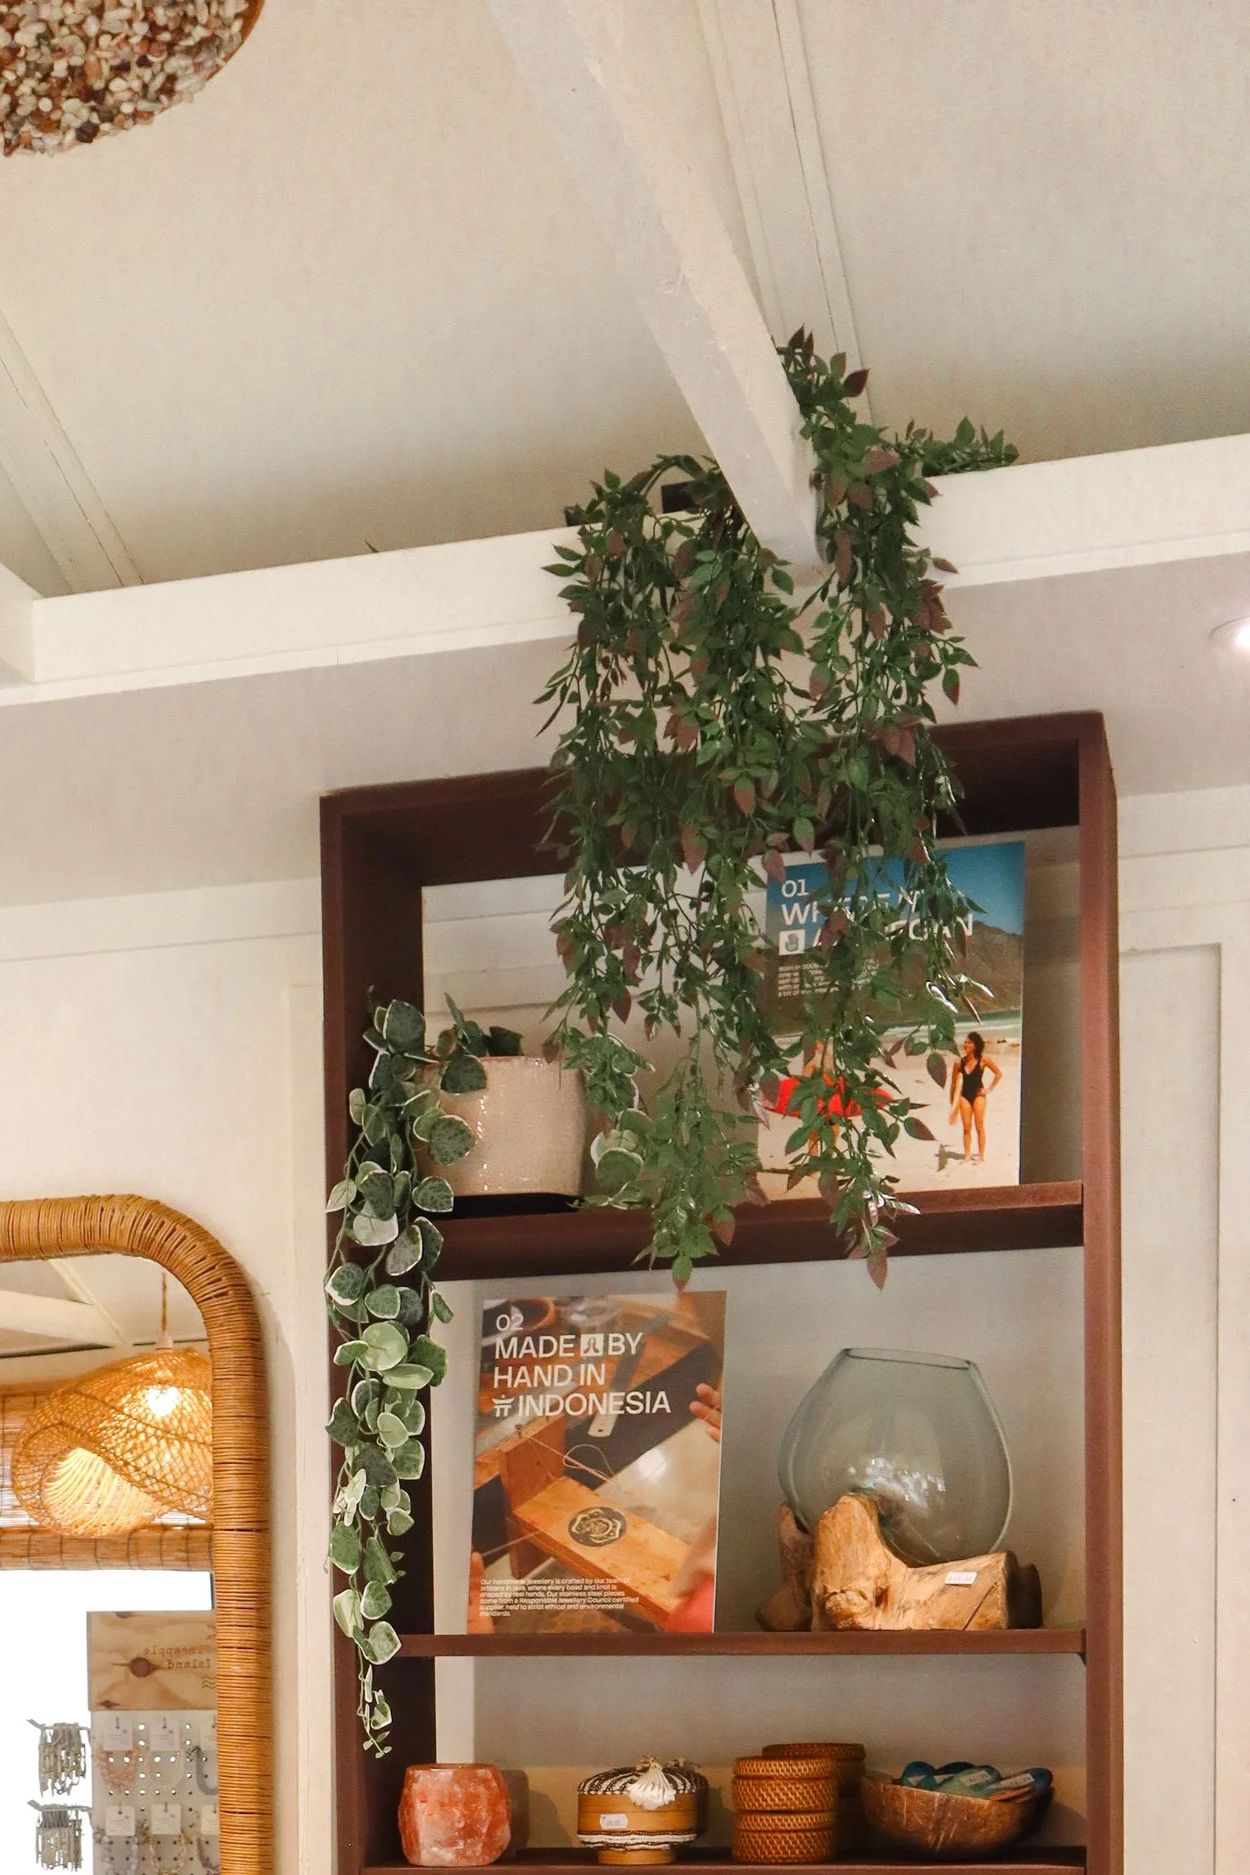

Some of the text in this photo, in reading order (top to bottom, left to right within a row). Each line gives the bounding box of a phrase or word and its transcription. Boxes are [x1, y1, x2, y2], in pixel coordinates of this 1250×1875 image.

[496, 1314, 524, 1332] 02
[495, 1333, 643, 1359] MADE BY
[493, 1363, 606, 1388] HAND IN
[518, 1391, 671, 1417] INDONESIA
